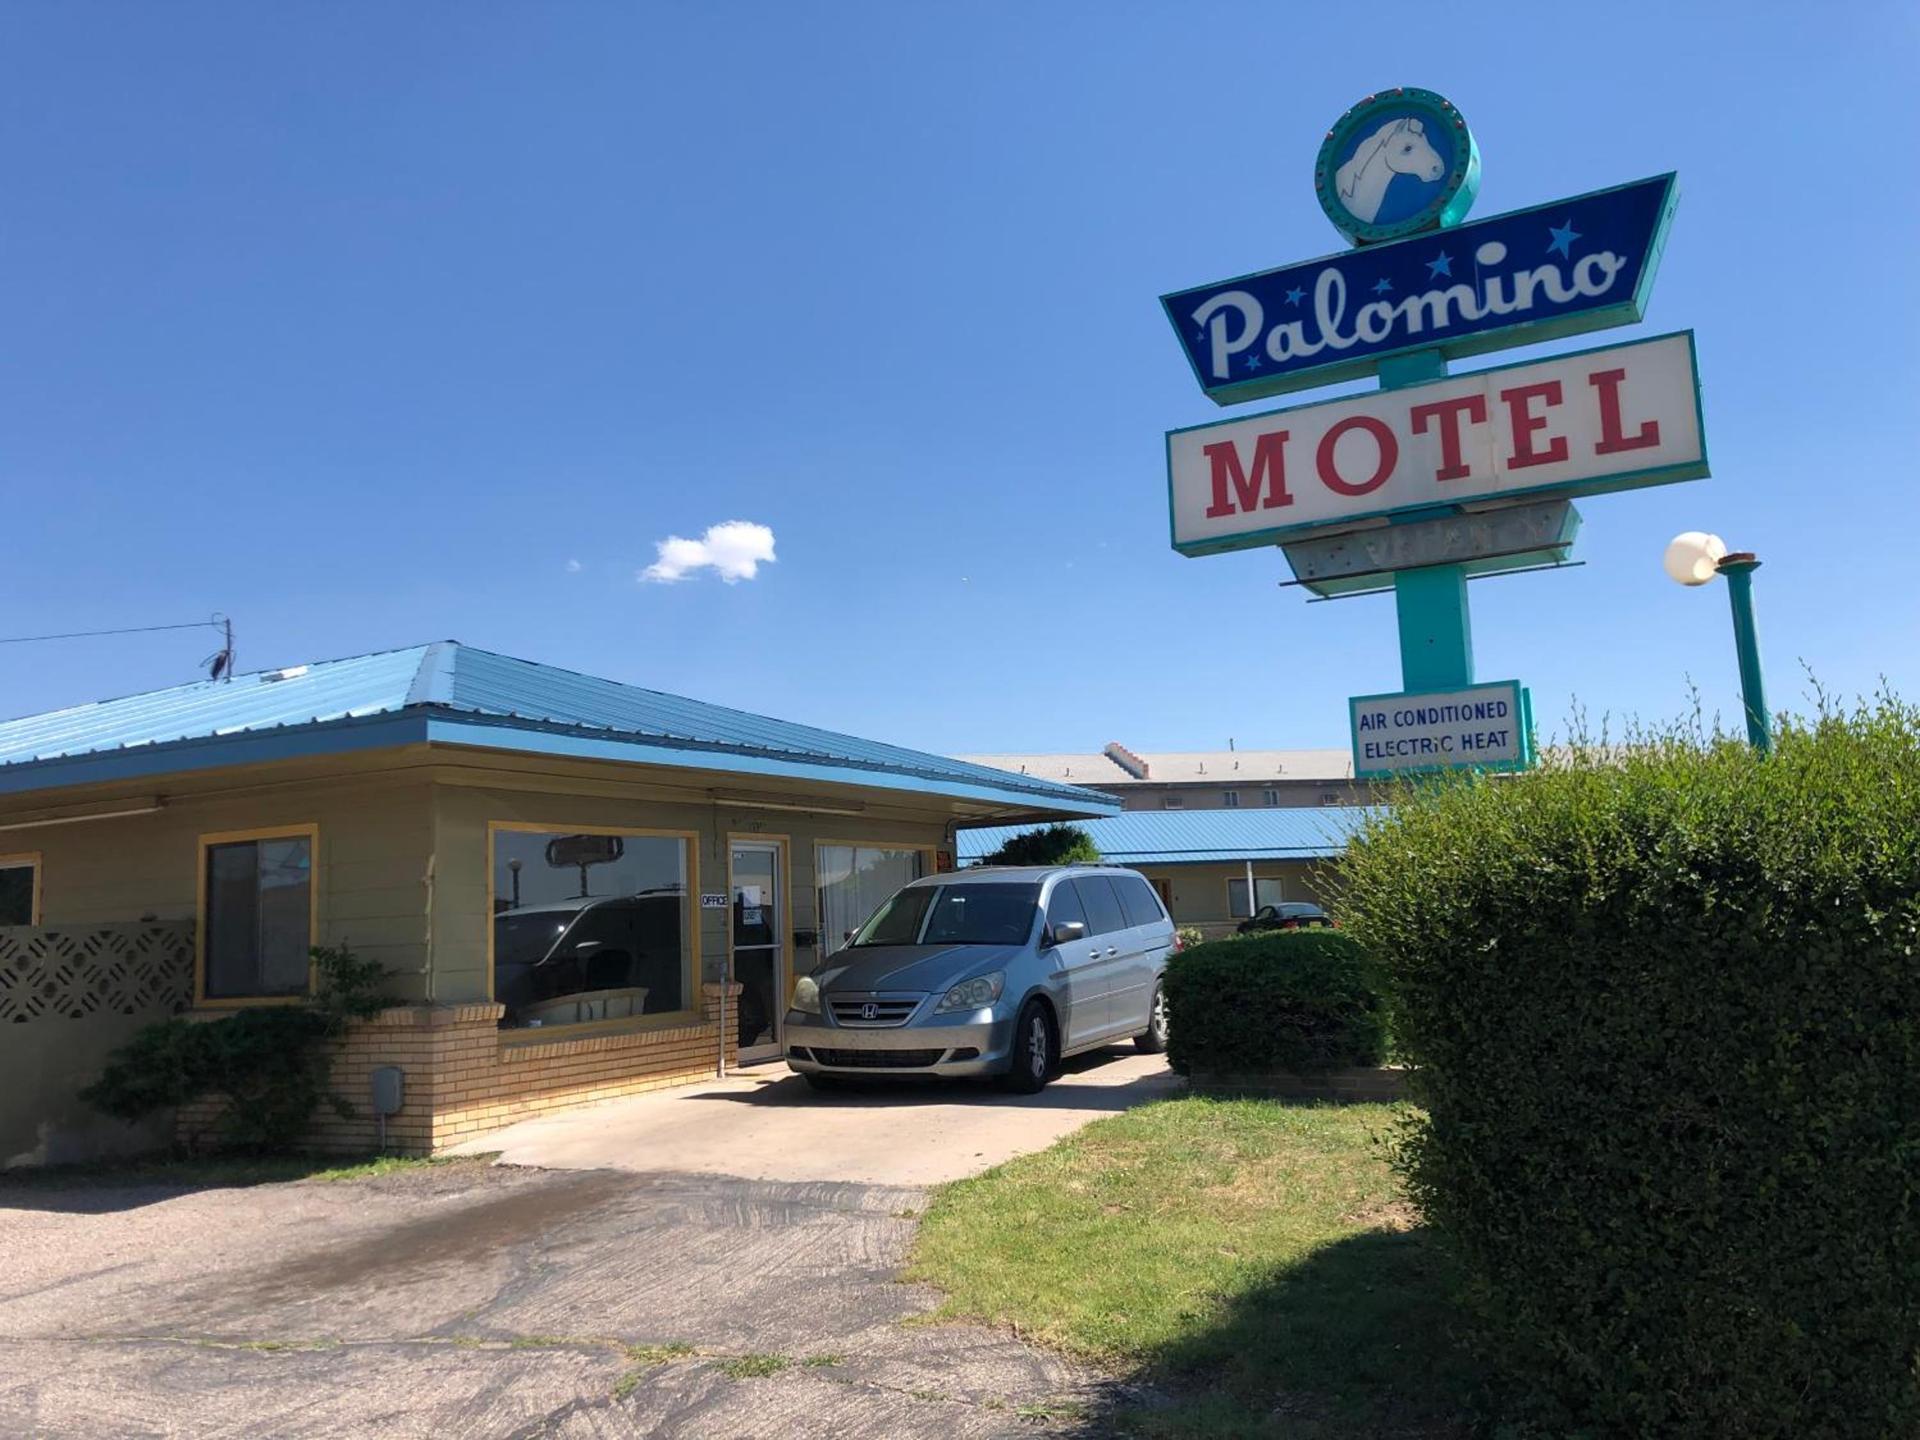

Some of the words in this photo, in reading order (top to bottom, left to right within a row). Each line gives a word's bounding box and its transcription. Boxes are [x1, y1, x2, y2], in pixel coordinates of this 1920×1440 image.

[1192, 242, 1627, 379] Palomino
[1203, 368, 1660, 518] MOTEL
[1360, 713, 1387, 731] AIR
[1394, 701, 1508, 728] CONDITIONED
[1462, 731, 1509, 750] HEAT
[702, 895, 728, 906] OFFICE
